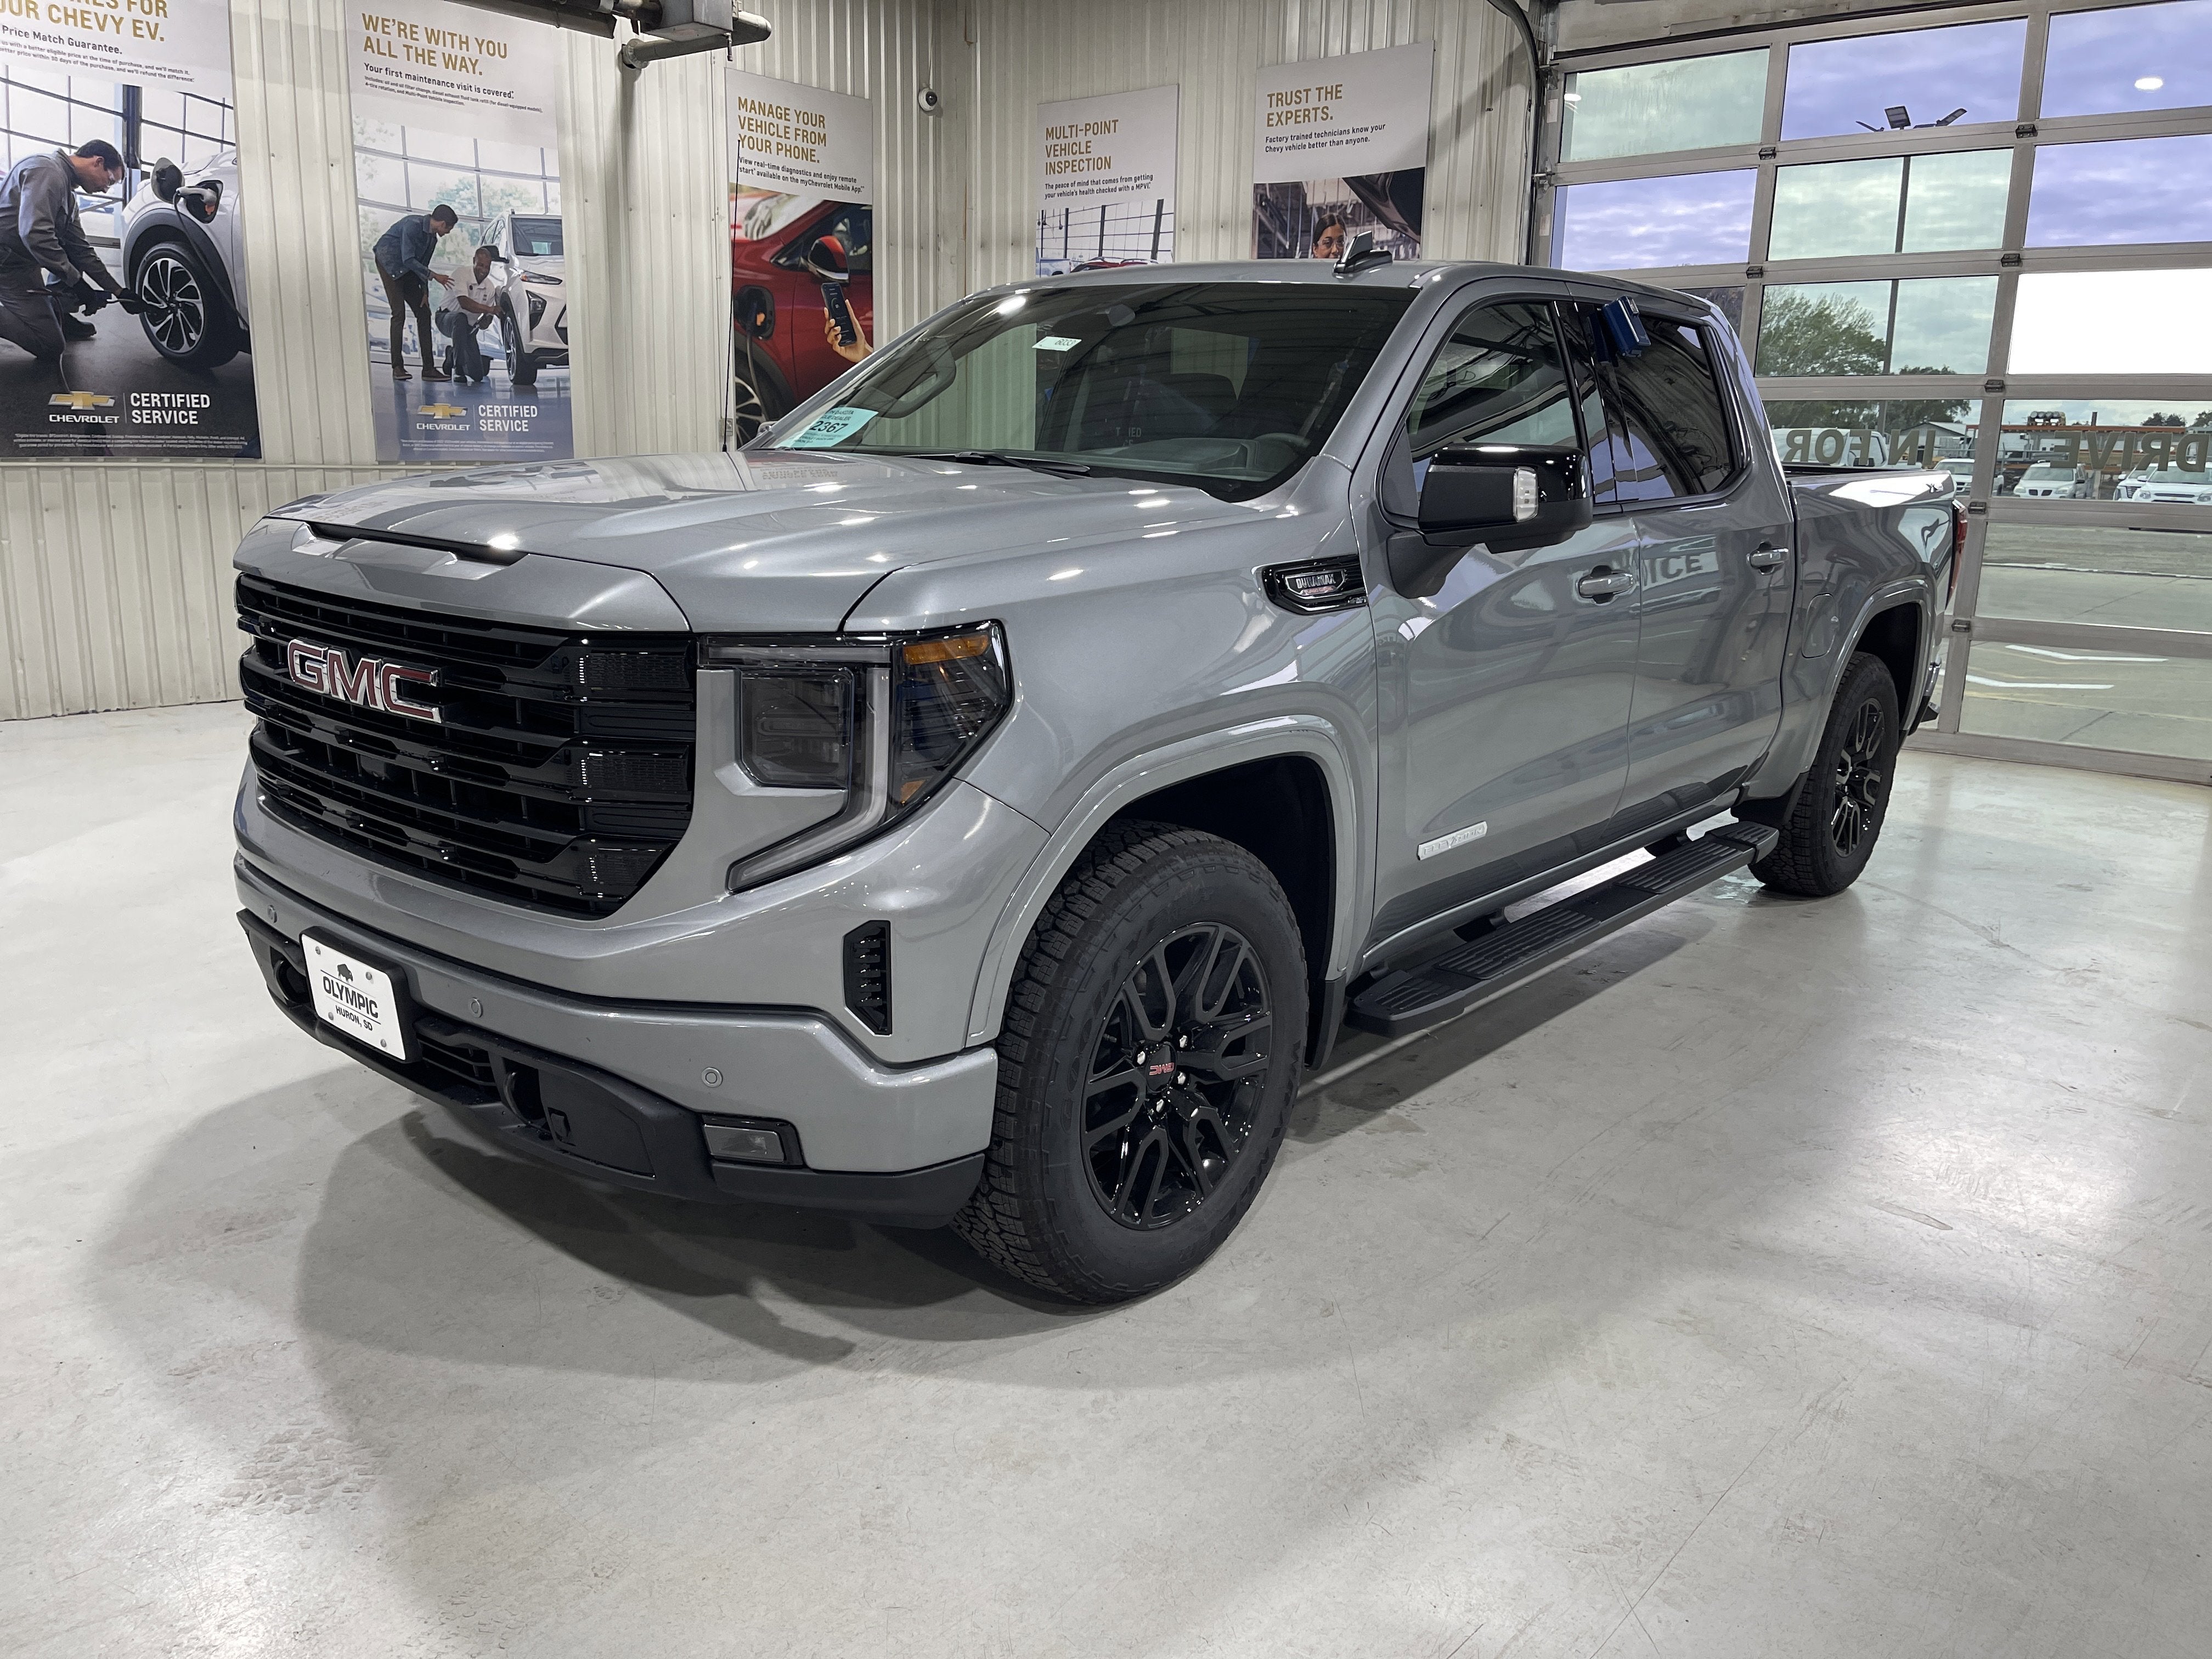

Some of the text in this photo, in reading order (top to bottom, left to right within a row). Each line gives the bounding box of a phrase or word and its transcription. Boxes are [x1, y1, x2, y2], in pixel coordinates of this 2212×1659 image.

[127, 0, 167, 18] FOR
[48, 4, 124, 34] CHEVY
[132, 19, 164, 41] EV.
[2, 25, 122, 54] Price Match Guarantee.
[362, 13, 507, 59] WE'RE WITH YOU
[363, 36, 482, 76] ALL THE WAY.
[364, 62, 383, 74] Your
[385, 67, 403, 78] first
[405, 73, 455, 88] maintenance
[456, 82, 472, 92] visit
[475, 84, 481, 93] is
[1267, 84, 1343, 108] TRUST THE
[738, 96, 825, 129] MANAGE YOUR
[1267, 105, 1333, 127] EXPERTS.
[738, 115, 826, 147] VEHICLE FROM
[1046, 119, 1119, 141] MULTI-POINT
[1290, 132, 1313, 141] trained
[1314, 129, 1350, 138] technicians
[1370, 123, 1386, 133] your
[738, 133, 820, 163] YOUR PHONE.
[1045, 140, 1092, 158] VEHICLE
[1265, 145, 1284, 154] Chevy
[1285, 143, 1307, 151] vehicle
[1345, 137, 1370, 146] anyone.
[738, 156, 752, 165] View
[754, 161, 780, 171] real-time
[781, 165, 812, 177] diagnostics
[824, 173, 837, 182] enjoy
[1046, 156, 1111, 175] INSPECTION
[757, 171, 780, 180] available
[800, 178, 833, 189] myChevrolet
[834, 183, 850, 191] Mobile
[1133, 173, 1153, 183] getting
[1057, 189, 1078, 198] vehicle's
[1096, 185, 1117, 194] checked
[130, 392, 211, 408] CERTIFIED
[49, 414, 120, 424] CHEVROLET
[132, 410, 199, 425] SERVICE
[478, 405, 538, 418] CERTIFIED
[416, 422, 470, 431] CHEVROLET
[479, 419, 529, 432] SERVICE
[809, 420, 849, 433] 2367
[1295, 573, 1336, 589] DURAMAX
[287, 636, 442, 724] GMC
[323, 976, 379, 1018] OLYMPIC
[335, 1005, 373, 1031] HURON, SD
[1149, 1062, 1175, 1075] GMC
